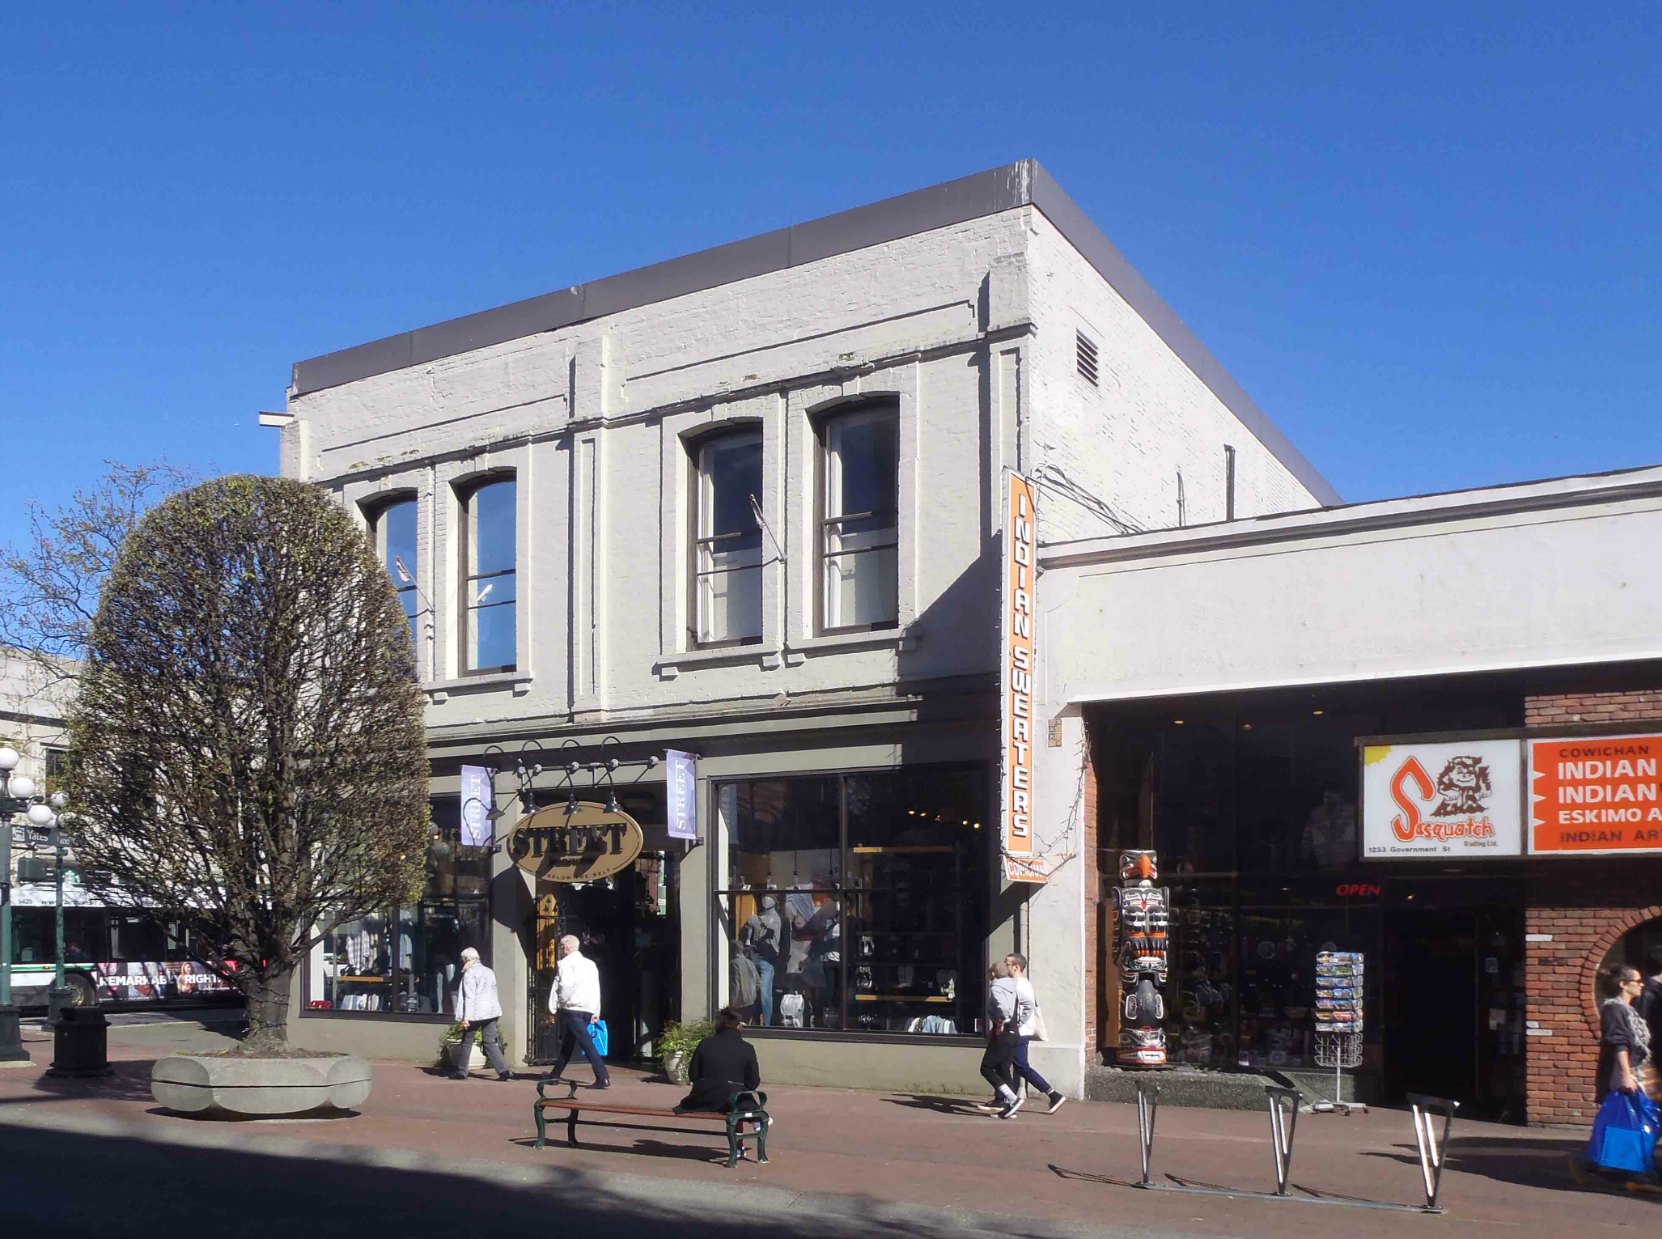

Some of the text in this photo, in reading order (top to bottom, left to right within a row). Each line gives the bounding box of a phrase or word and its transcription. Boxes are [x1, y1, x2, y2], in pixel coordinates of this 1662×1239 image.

[1010, 493, 1032, 840] INDIAN SWEATERS
[1559, 746, 1649, 758] COWICHAN
[1558, 758, 1657, 780] INDIAN
[674, 760, 686, 830] STREET
[1389, 755, 1497, 843] Sasquatch
[1558, 783, 1657, 804] INDIAN
[1558, 808, 1642, 825] ESKIMO
[512, 823, 628, 861] STREET
[1560, 829, 1662, 844] INDIAN AR
[1336, 884, 1381, 896] OPEN
